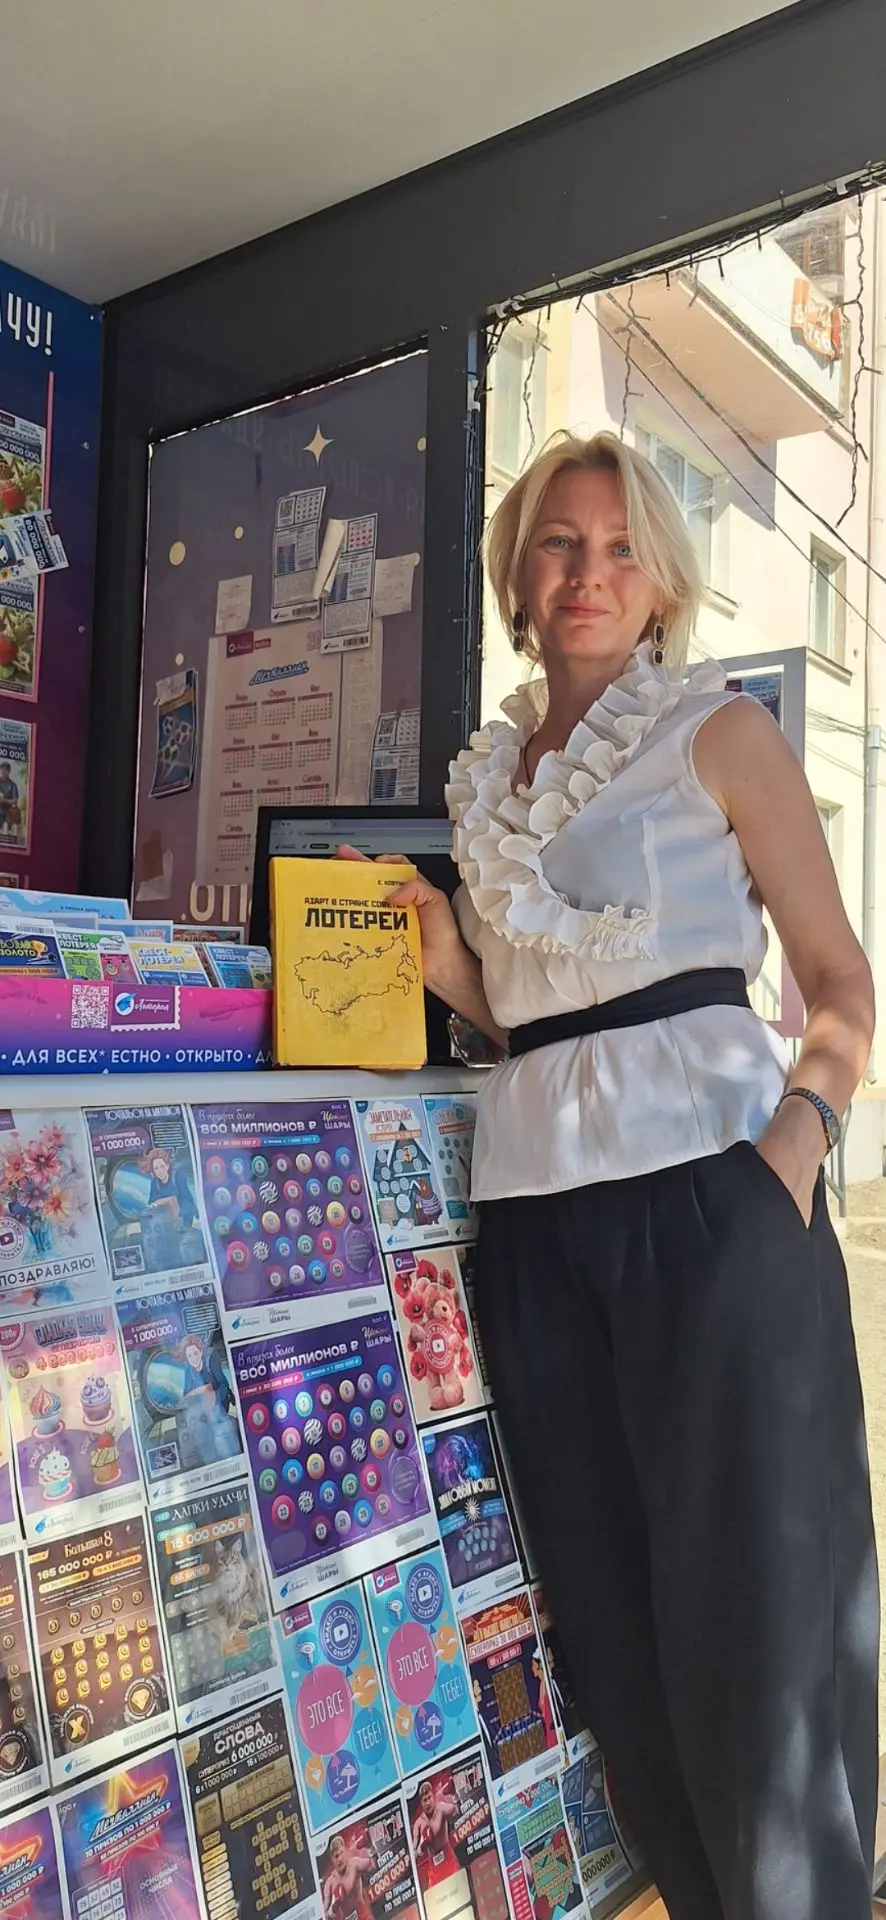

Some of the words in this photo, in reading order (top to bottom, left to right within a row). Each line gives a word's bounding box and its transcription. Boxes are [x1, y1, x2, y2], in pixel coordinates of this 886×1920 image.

[0, 292, 53, 356] ЧУ!
[339, 899, 369, 908] СТРАНЕ
[305, 908, 408, 930] ЛОТЕРЕИ
[12, 1050, 48, 1066] ДЛЯ
[112, 1050, 161, 1064] ЕСТНО
[176, 1049, 243, 1064] ОТКРЫТО
[200, 1123, 228, 1135] 800
[232, 1121, 305, 1134] МИЛЛИОНОВ
[107, 1140, 124, 1150] 000
[125, 1137, 141, 1148] 000
[0, 1257, 96, 1288] ПОЗДРАВЛЯЮ!
[139, 1329, 157, 1342] 000
[157, 1324, 173, 1336] 000
[366, 1335, 392, 1348] ШАРЫ
[239, 1364, 267, 1382] 800
[270, 1342, 348, 1373] МИЛЛИОНОВ
[334, 1422, 341, 1431] 11
[289, 1469, 297, 1478] 16
[172, 1501, 210, 1520] ЛАПКИ
[211, 1489, 248, 1509] УДАЧИ
[325, 1490, 333, 1499] 24
[103, 1530, 113, 1547] 8
[186, 1530, 210, 1544] 000
[212, 1521, 235, 1536] 000
[58, 1560, 80, 1574] 000
[82, 1553, 104, 1567] 000
[317, 1568, 339, 1582] ШАРЫ
[396, 1654, 414, 1682] ЭТО
[412, 1645, 430, 1674] ВСЕ
[307, 1698, 326, 1729] ЭТО
[327, 1689, 345, 1720] ВСЕ
[214, 1721, 265, 1754] СЛОВА
[356, 1719, 383, 1752] ТЕБЕ!
[230, 1749, 238, 1763] 6
[237, 1743, 256, 1759] 000
[255, 1732, 273, 1750] 000
[458, 1821, 472, 1840] 000
[471, 1810, 485, 1827] 000
[140, 1863, 178, 1890] ОСНОВНЫЕ
[148, 1876, 173, 1894] ЧИСЛА
[374, 1875, 390, 1896] 000
[390, 1860, 405, 1880] 000
